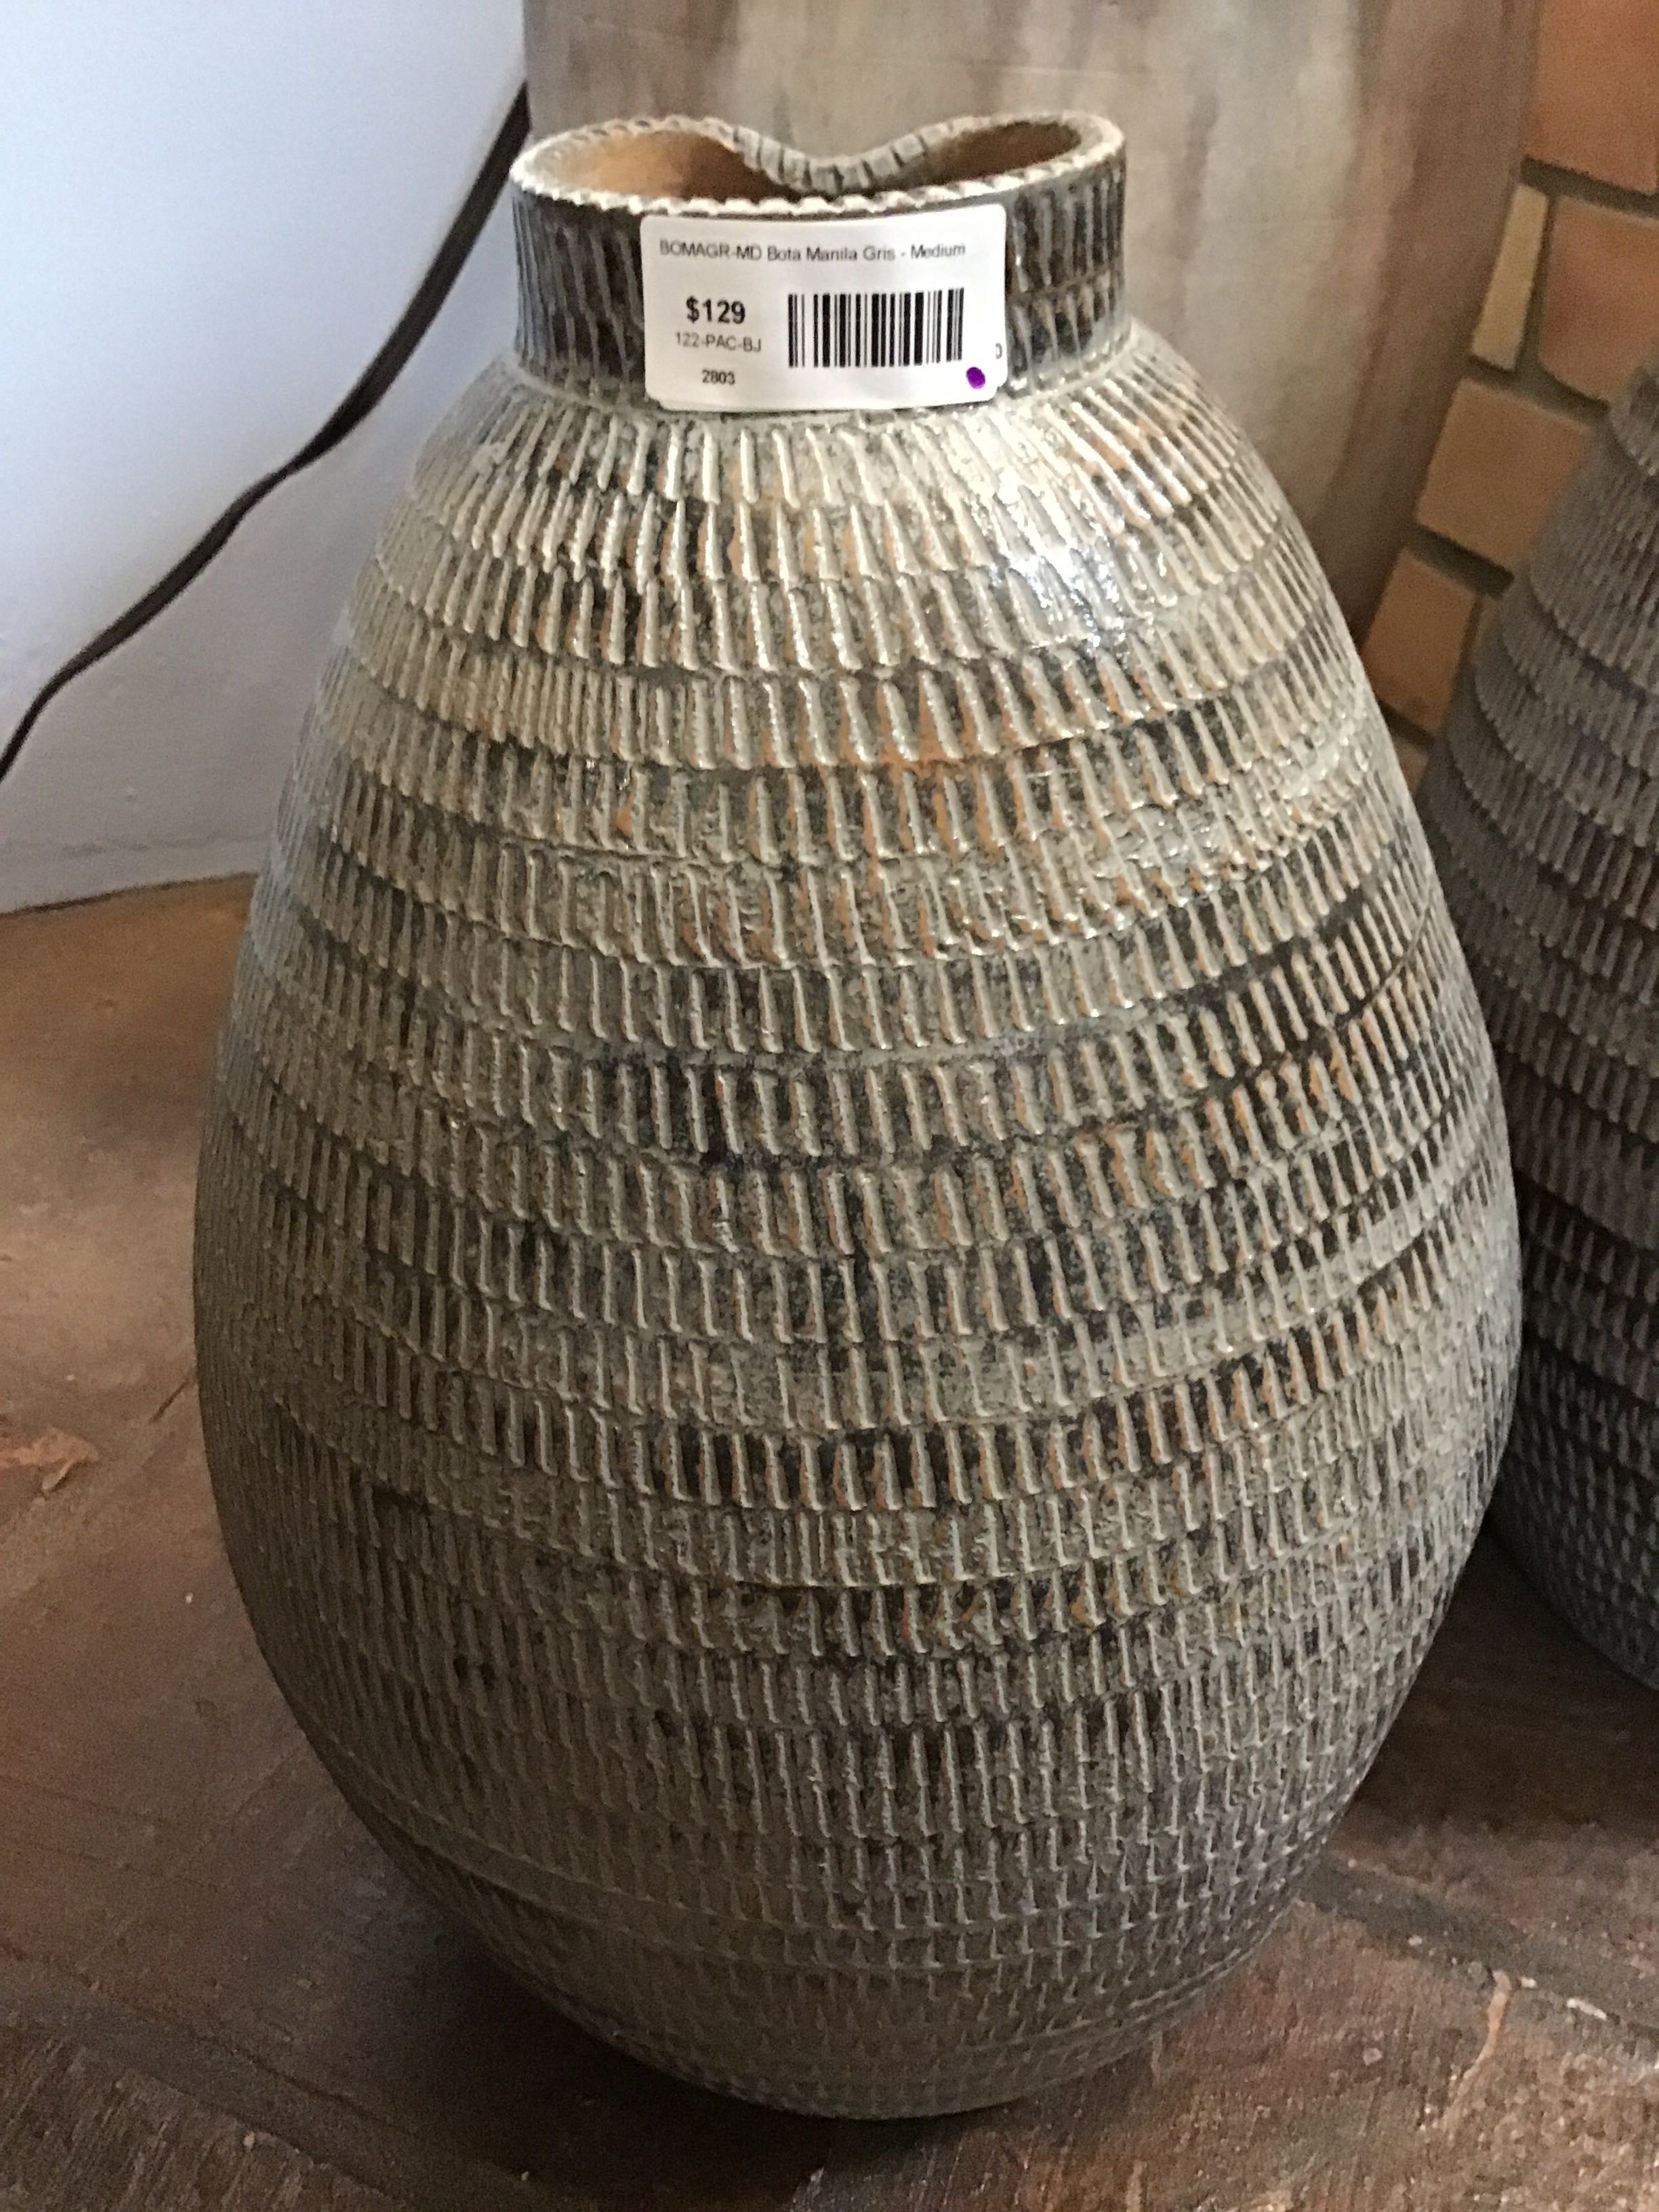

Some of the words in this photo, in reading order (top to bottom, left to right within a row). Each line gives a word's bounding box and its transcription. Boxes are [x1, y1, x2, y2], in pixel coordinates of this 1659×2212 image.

[659, 240, 762, 262] BOMAGR-MD
[768, 245, 801, 262] Bota
[806, 245, 857, 261] Manila
[863, 245, 895, 261] Gris
[911, 243, 966, 259] Medium
[687, 295, 745, 325] $129
[676, 331, 761, 352] 122-PAC-BJ
[702, 369, 735, 385] 2803
